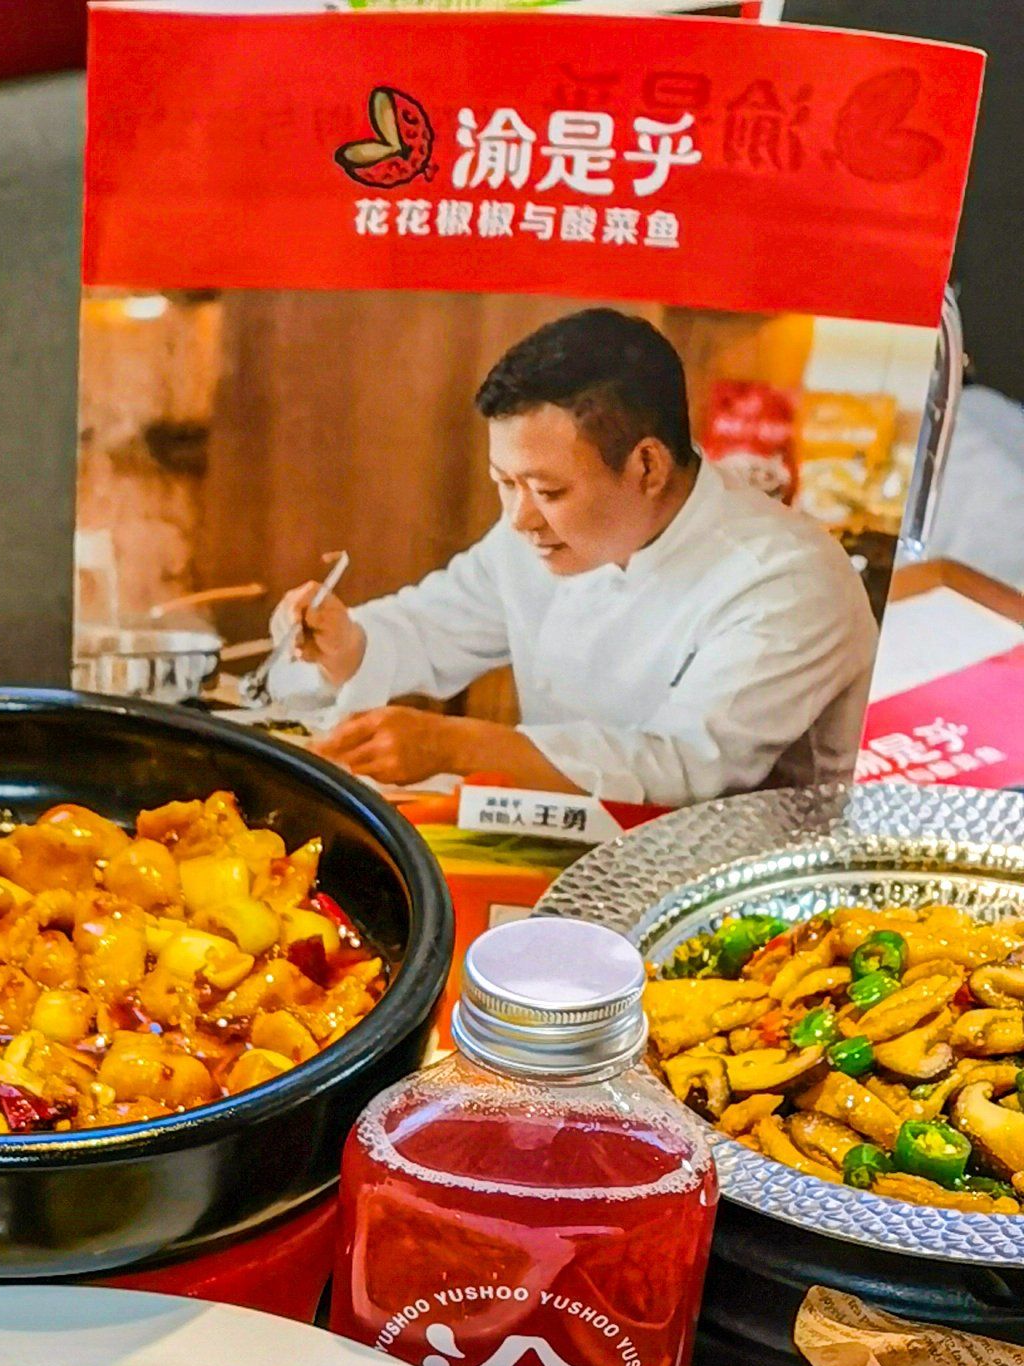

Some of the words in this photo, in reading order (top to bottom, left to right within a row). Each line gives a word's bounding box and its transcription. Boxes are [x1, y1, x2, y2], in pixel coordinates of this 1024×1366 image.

[451, 107, 702, 197] 渝是乎
[354, 198, 679, 249] 花花椒椒与酸菜鱼
[374, 1299, 430, 1352] YUSHOO
[434, 1285, 529, 1306] YUSHOO
[539, 1291, 620, 1338] YUSHOO
